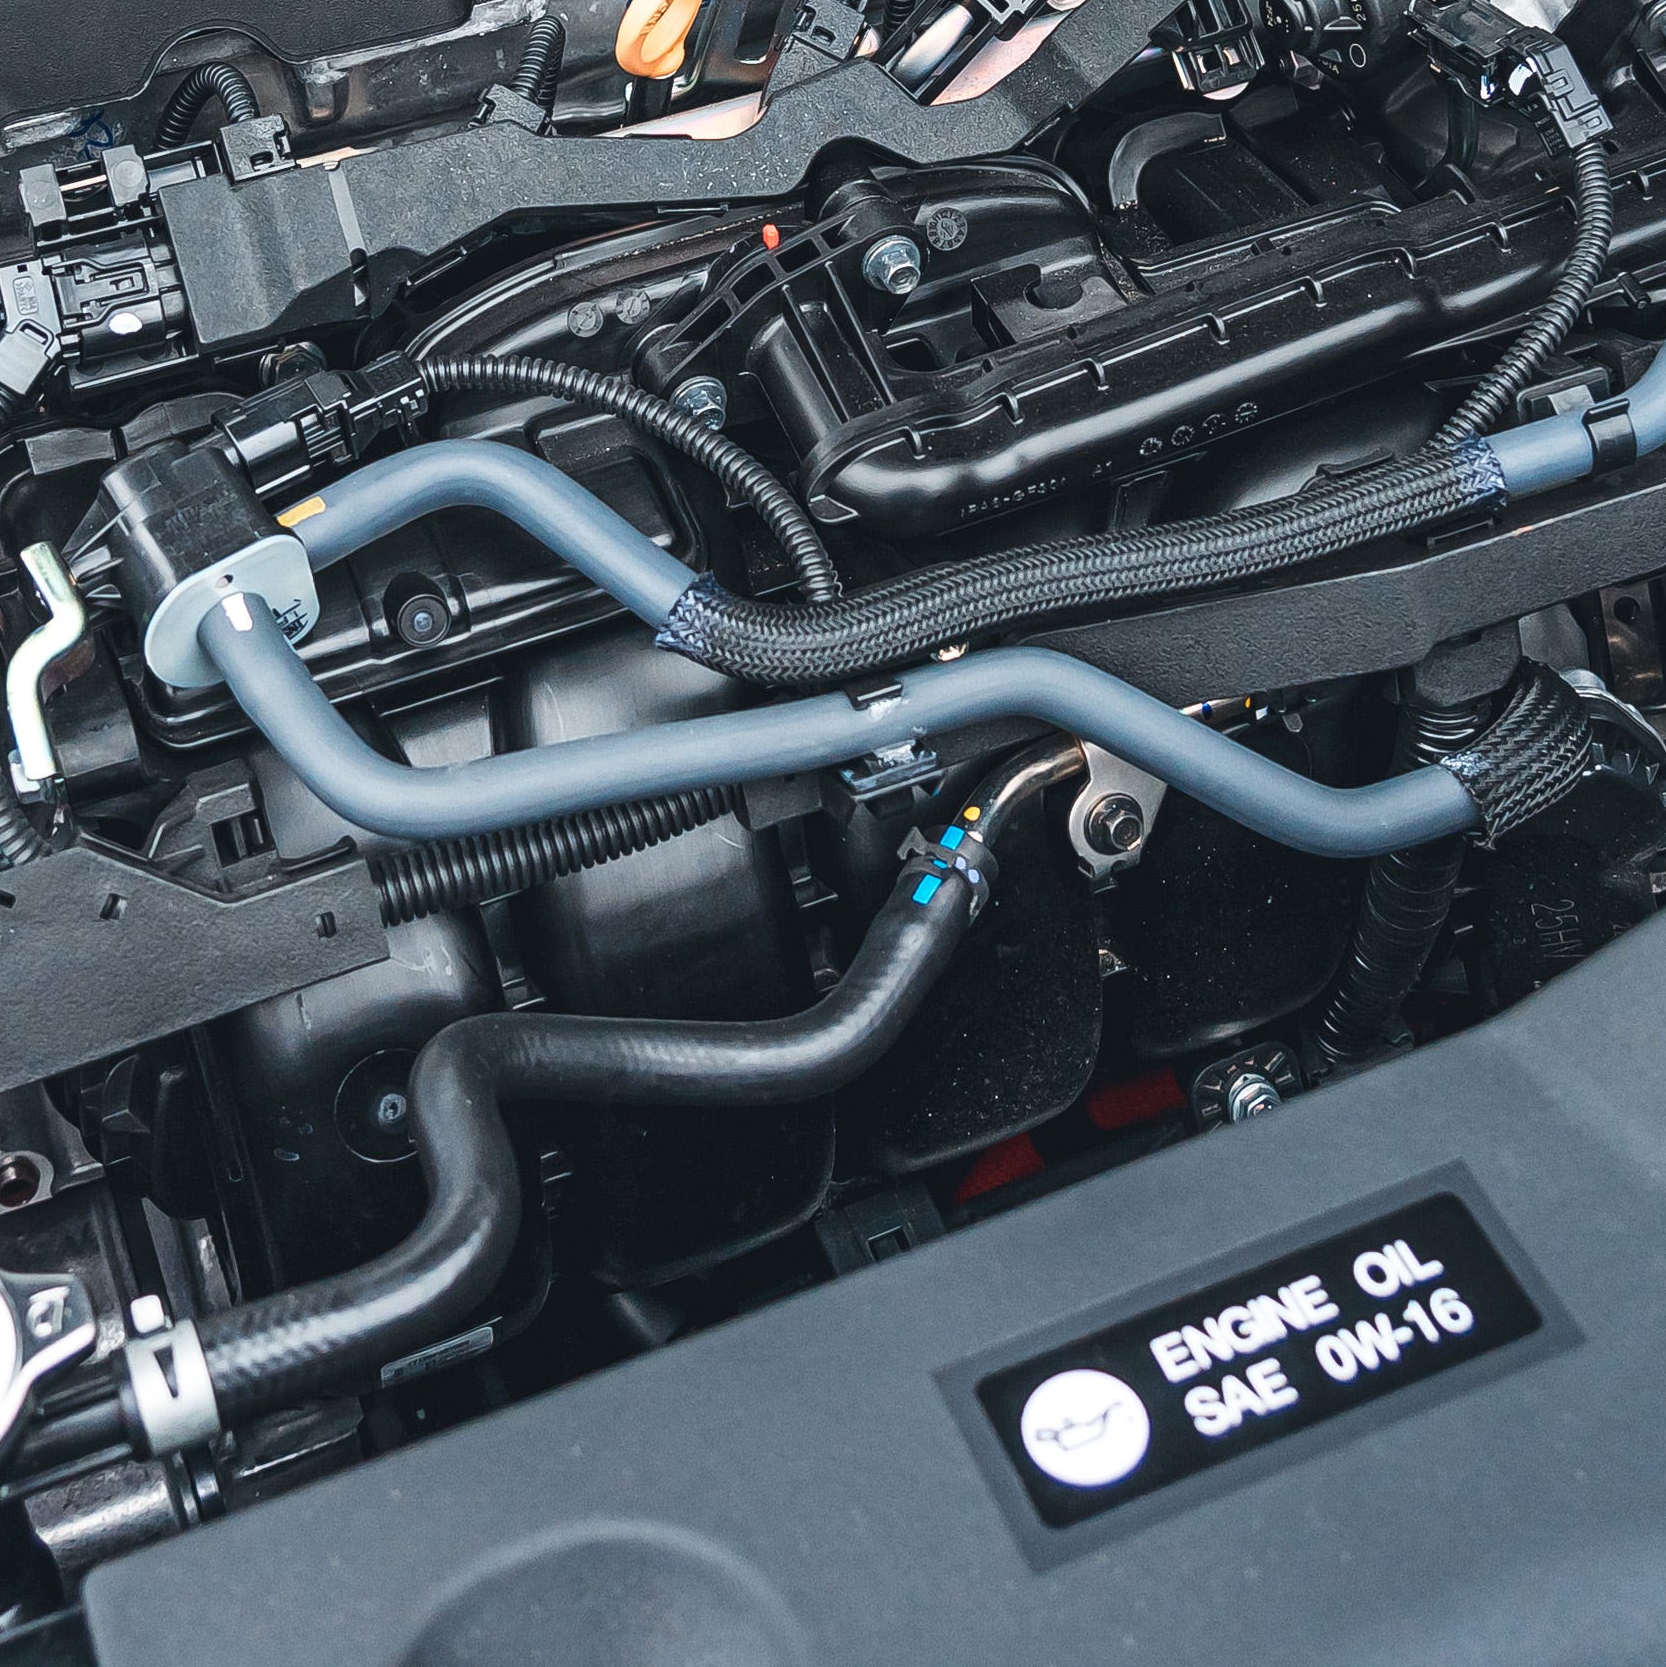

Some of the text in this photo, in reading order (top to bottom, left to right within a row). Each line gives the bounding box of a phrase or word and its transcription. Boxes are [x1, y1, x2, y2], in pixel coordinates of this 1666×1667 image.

[1149, 1238, 1445, 1384] ENGINE OIL
[1183, 1286, 1475, 1438] SAE 0W-16
